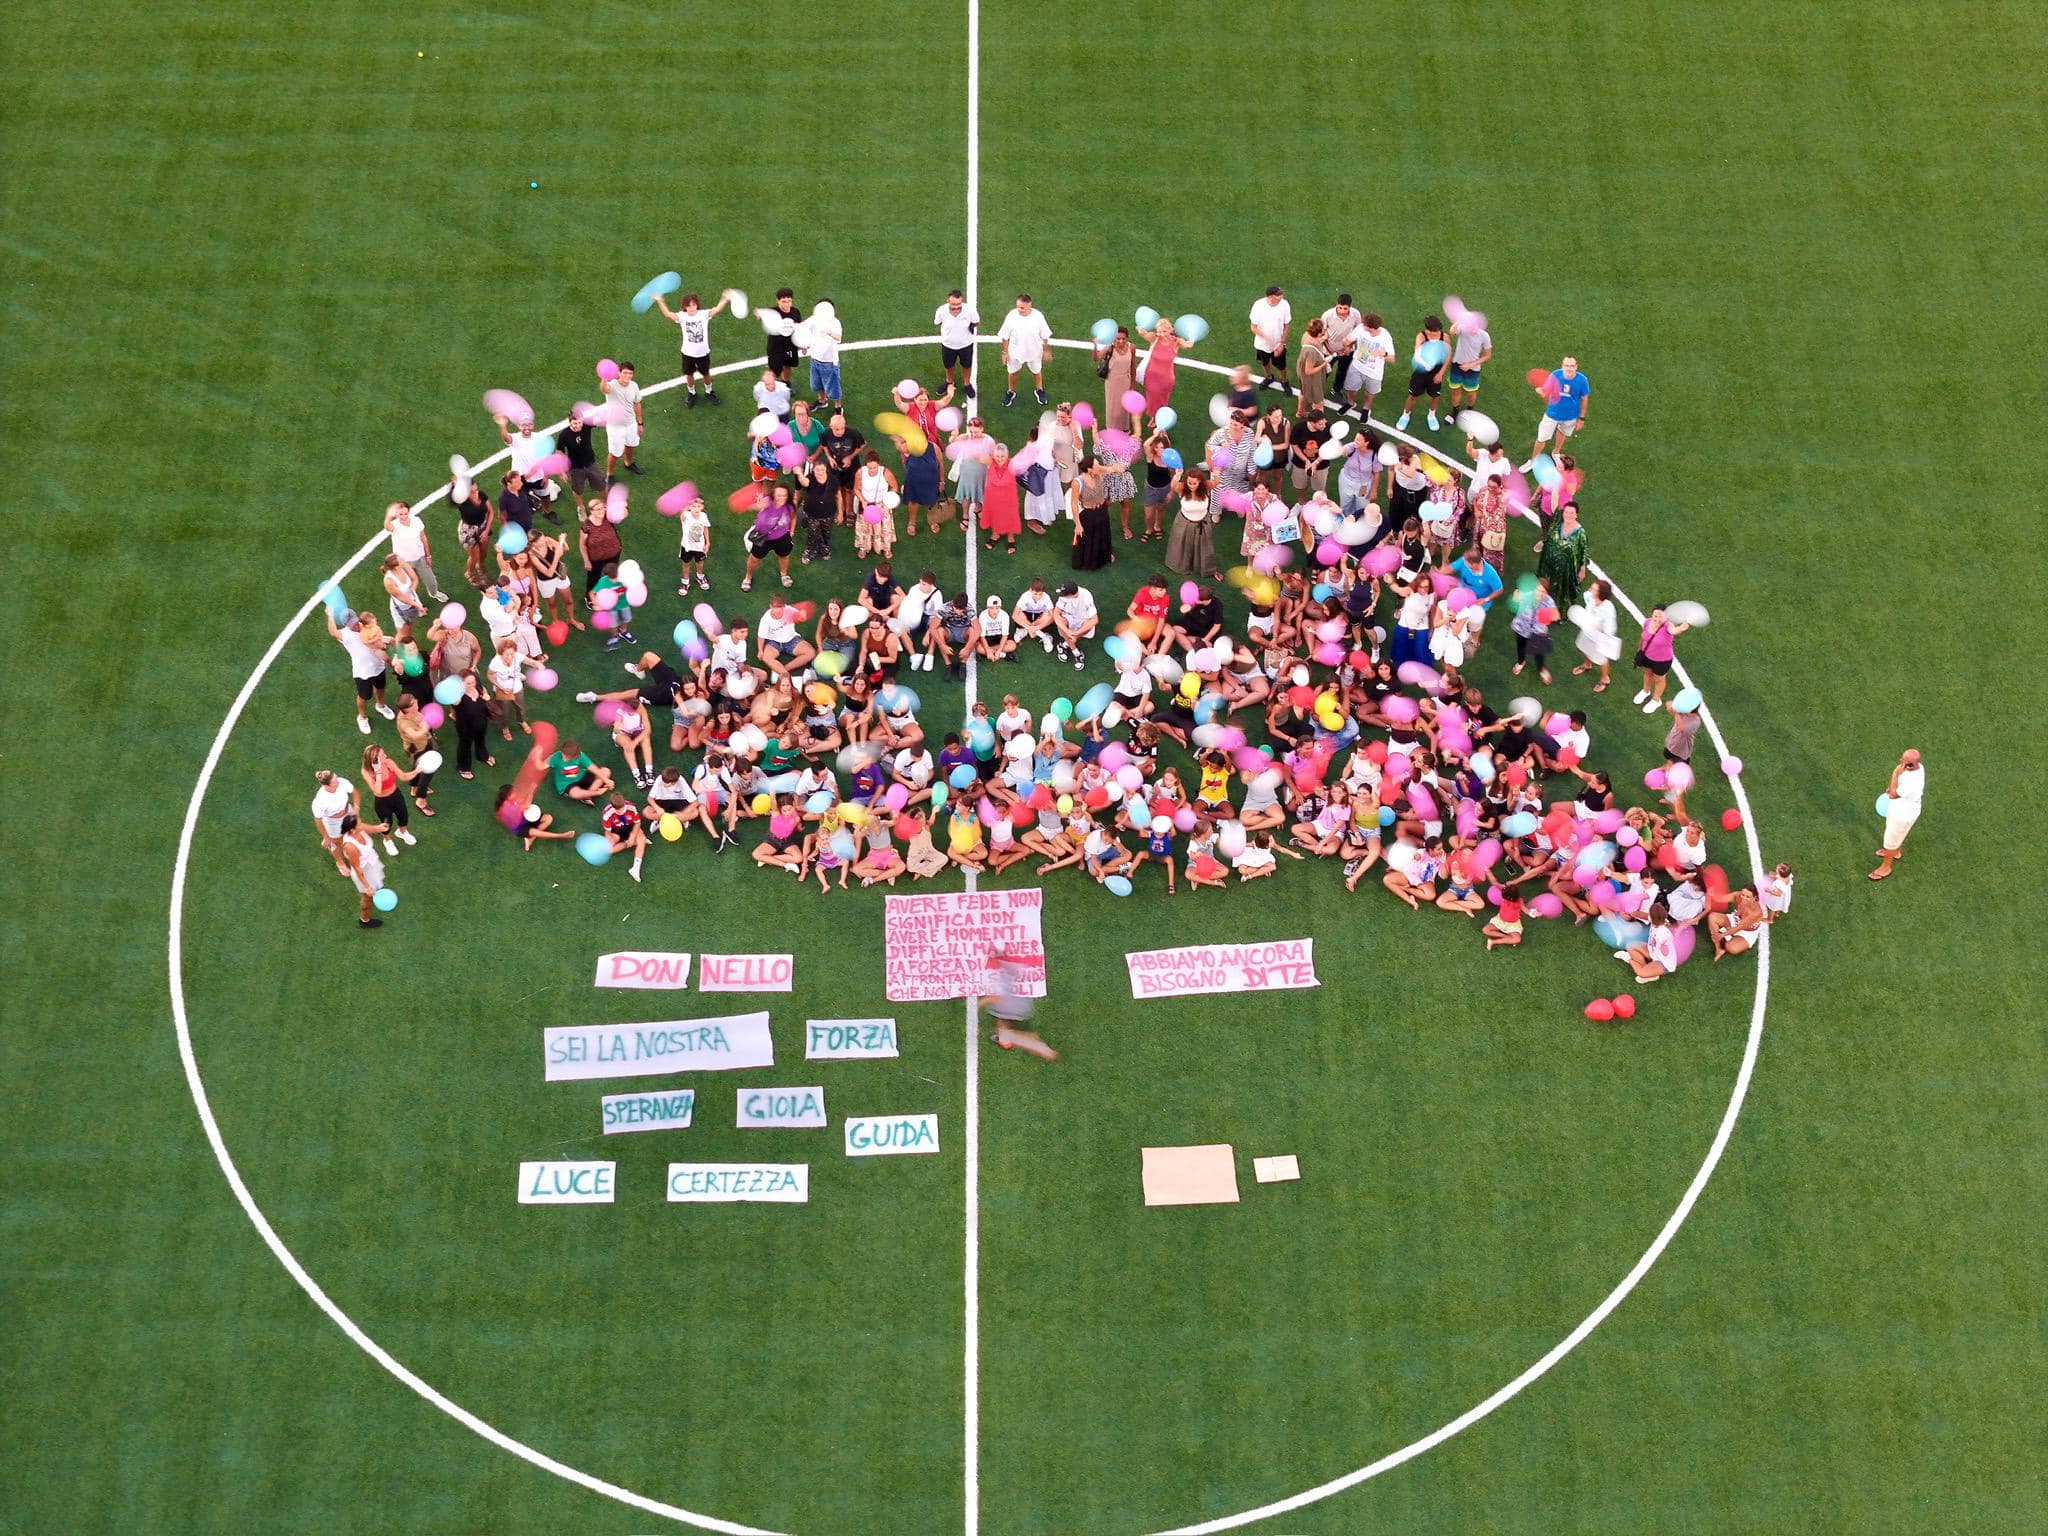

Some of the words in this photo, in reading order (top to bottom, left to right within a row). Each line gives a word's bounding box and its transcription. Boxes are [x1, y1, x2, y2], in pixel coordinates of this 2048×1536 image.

[887, 896, 948, 914] AVERE
[957, 893, 1000, 910] FEDE
[1008, 892, 1040, 908] NON
[887, 913, 975, 930] SIGNIFICA
[980, 911, 1016, 924] NON
[887, 928, 938, 944] AVERE
[945, 925, 1025, 942] MOMENTI
[973, 942, 998, 956] MA
[1130, 951, 1215, 971] ABBIAMO
[1219, 943, 1305, 967] ANCORA
[611, 956, 683, 983] DON
[701, 958, 790, 985] NELLO
[889, 962, 905, 975] LA
[908, 958, 967, 974] FORZA
[966, 958, 982, 971] DI
[889, 986, 919, 999] CHE
[924, 985, 950, 997] NON
[1008, 984, 1033, 996] OLI
[1138, 970, 1226, 993] BISOGNO
[550, 1036, 588, 1064] SEI
[597, 1034, 627, 1062] LA
[635, 1026, 731, 1060] NOSTRA
[809, 1025, 895, 1052] FORZA
[745, 1094, 821, 1119] GIOIA
[849, 1119, 934, 1148] GUIDA
[530, 1166, 611, 1196] LUCE
[671, 1169, 799, 1195] CERTEZZA
